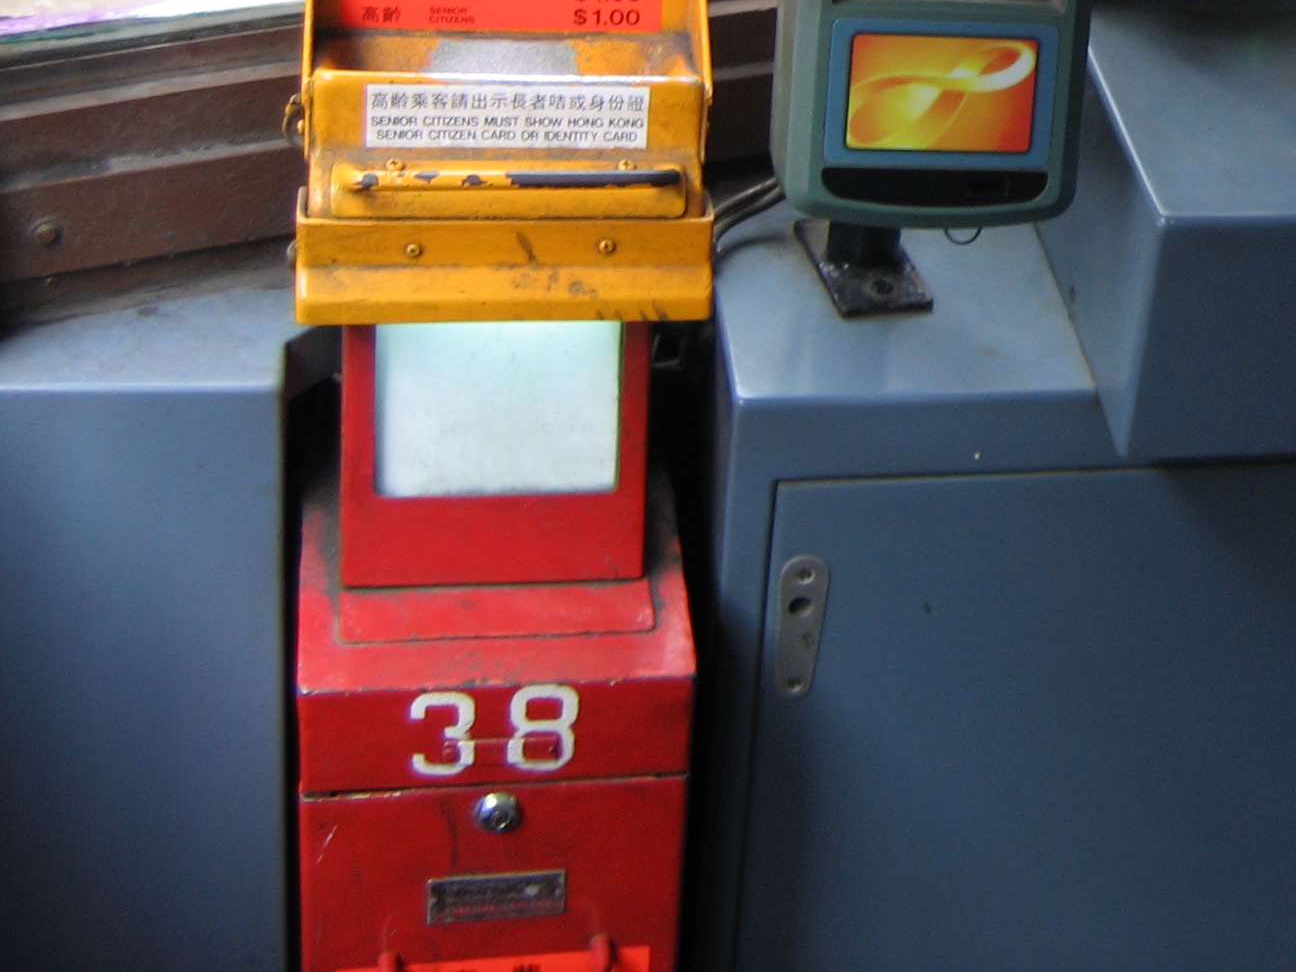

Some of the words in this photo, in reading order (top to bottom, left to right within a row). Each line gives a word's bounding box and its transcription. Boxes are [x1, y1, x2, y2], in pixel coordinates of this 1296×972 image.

[361, 6, 401, 24] 高齡
[429, 7, 468, 15] SENIOR
[573, 9, 641, 26] $1.00
[428, 16, 475, 24] CITIZENS
[371, 116, 418, 127] SENIOR
[422, 116, 480, 127] CITIZENS
[484, 116, 519, 127] MUST
[525, 116, 563, 128] SHOW
[567, 117, 604, 128] HONG
[608, 117, 645, 129] KONG
[376, 130, 423, 141] SENIOR
[428, 130, 477, 141] CITIZEN
[481, 130, 516, 141] CARD
[521, 130, 540, 141] OR
[544, 131, 599, 142] IDENTITY
[603, 132, 638, 143] CARD
[409, 684, 581, 776] 38
